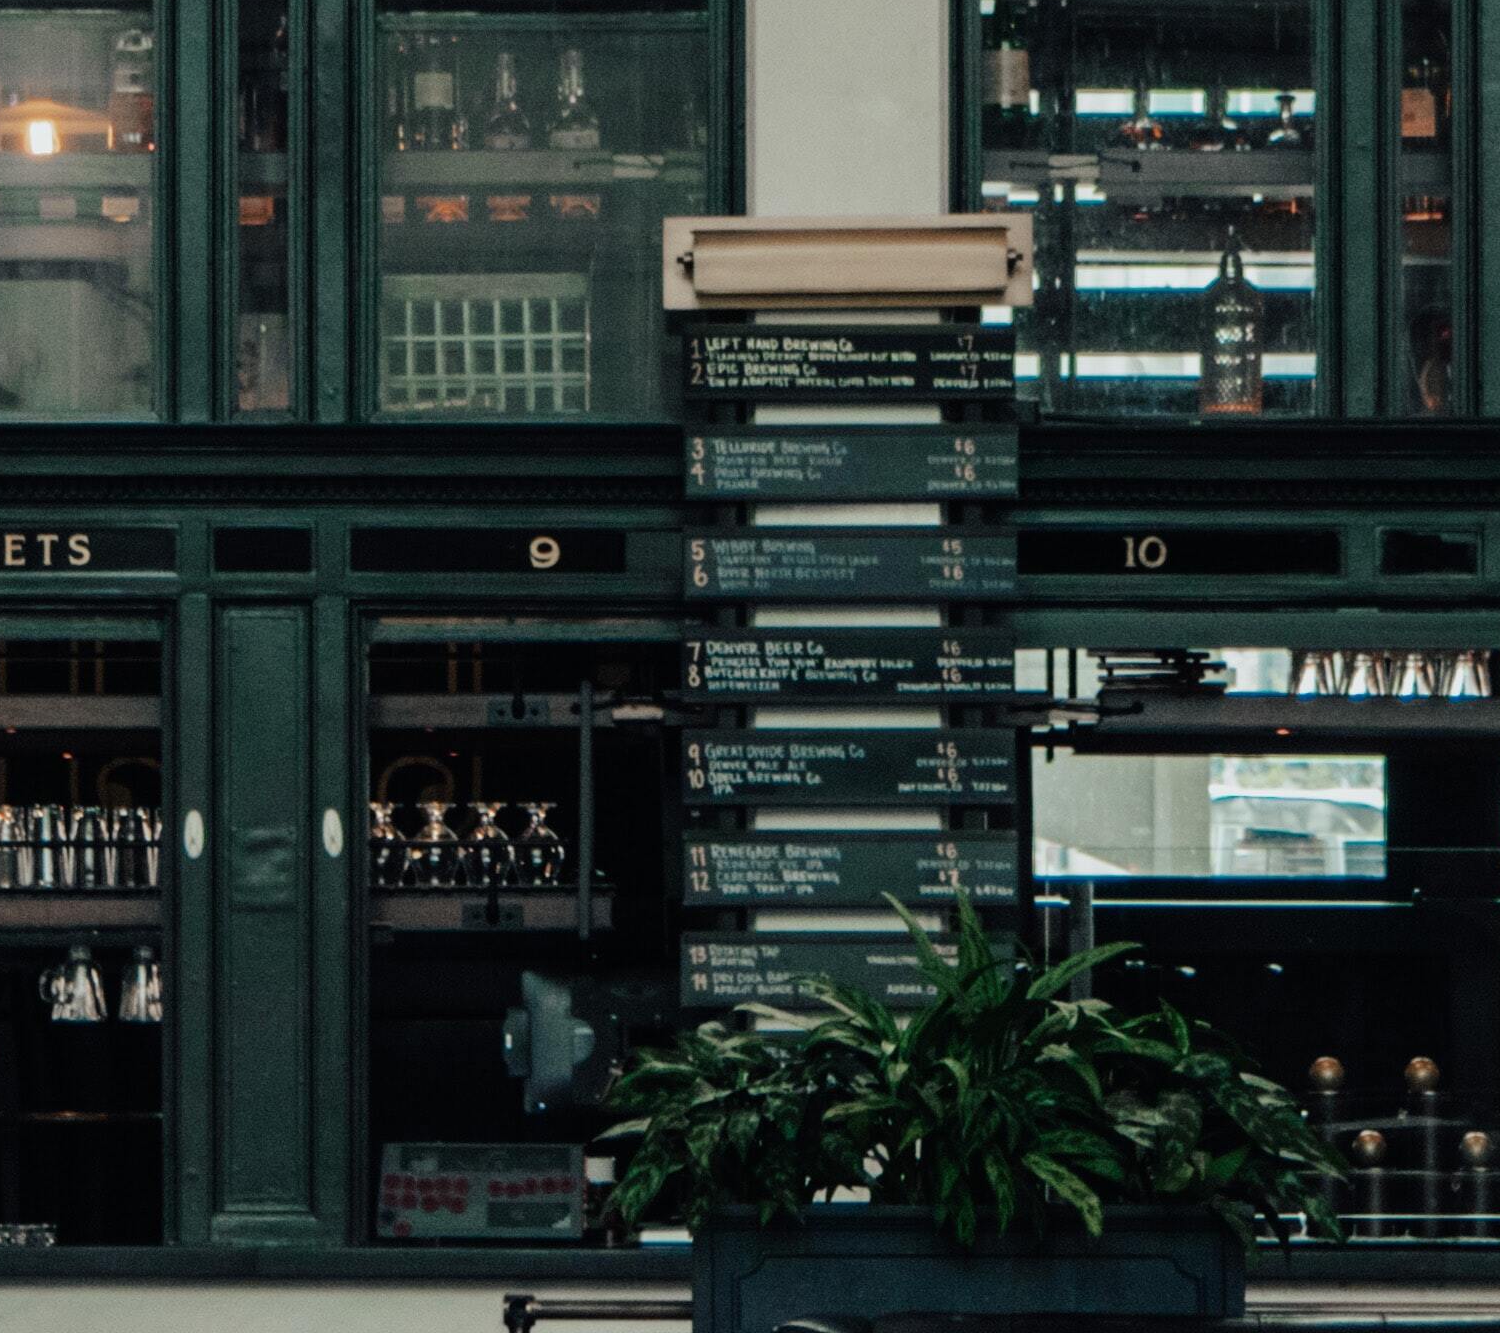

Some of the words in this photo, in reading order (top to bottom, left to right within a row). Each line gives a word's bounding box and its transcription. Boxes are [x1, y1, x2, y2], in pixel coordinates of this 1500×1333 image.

[691, 339, 700, 358] 1
[705, 337, 740, 351] LEFT
[783, 337, 837, 352] BREWING
[692, 363, 703, 385] 2
[706, 363, 739, 374] EPIC
[743, 363, 800, 377] BREWING
[692, 437, 704, 460] 3
[691, 463, 705, 485] 4
[529, 536, 561, 569] 9
[691, 539, 705, 561] 5
[1124, 537, 1167, 569] 10
[693, 564, 708, 587] 6
[687, 641, 701, 662] 7
[706, 640, 760, 655] DENVER
[764, 640, 804, 655] BEER
[689, 664, 701, 687] 8
[689, 744, 700, 766] 9
[705, 743, 743, 759] GREAT
[747, 745, 784, 758] DIVIDE
[790, 744, 846, 760] BREWING
[688, 769, 704, 789] 10
[691, 845, 706, 866] 11
[710, 844, 780, 859] RENEGADE
[785, 844, 841, 861] BREWING
[691, 871, 710, 891] 12
[782, 869, 840, 884] BREWING
[690, 946, 707, 965] 13
